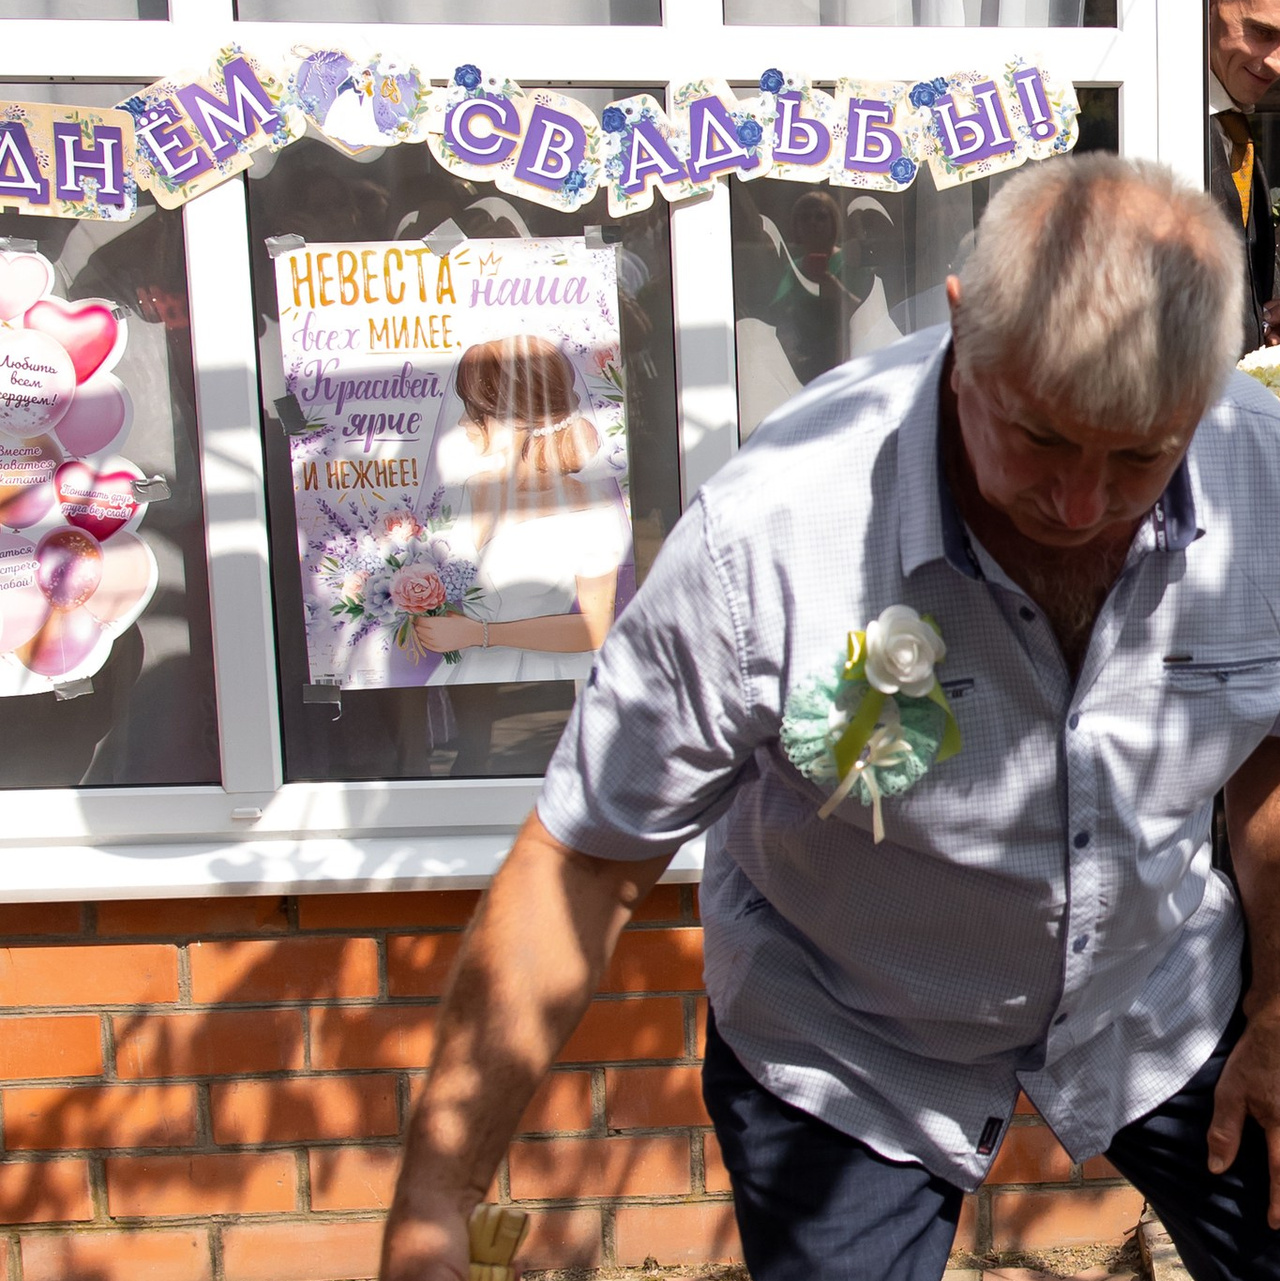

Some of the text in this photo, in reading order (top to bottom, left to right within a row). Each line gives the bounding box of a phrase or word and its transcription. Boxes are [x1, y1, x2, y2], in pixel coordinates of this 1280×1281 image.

[450, 74, 1055, 190] СВАДЬБЫ!
[289, 248, 590, 309] НЕВЕСТА наша
[292, 311, 462, 352] всех МИЛЕЕ,
[0, 354, 58, 374] Любить
[10, 370, 43, 389] всем
[301, 358, 444, 416] Красивей,
[342, 412, 423, 453] ярче
[302, 457, 419, 491] И НЕЖНЕЕ!
[0, 561, 38, 576] стрече
